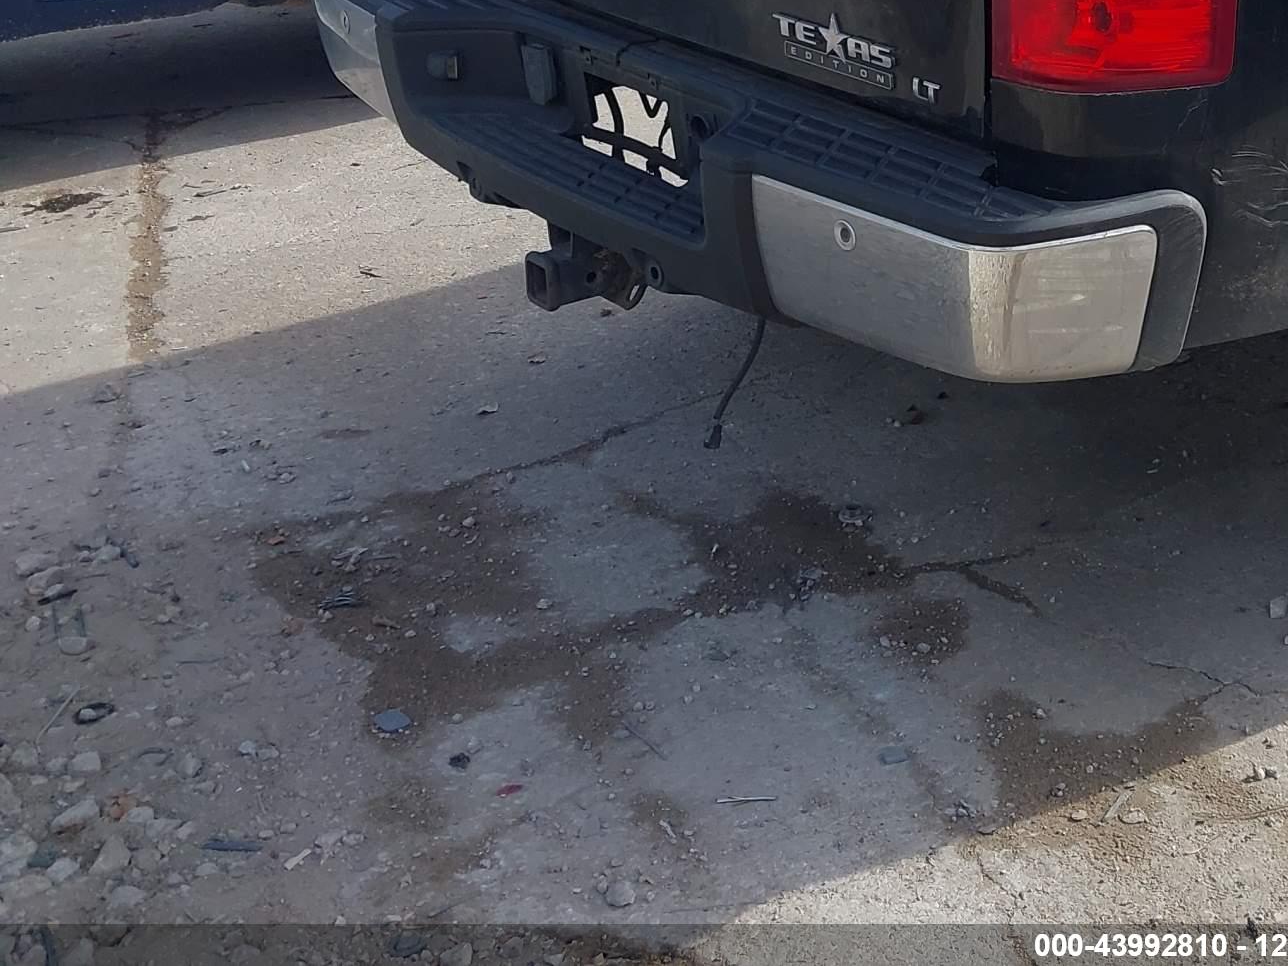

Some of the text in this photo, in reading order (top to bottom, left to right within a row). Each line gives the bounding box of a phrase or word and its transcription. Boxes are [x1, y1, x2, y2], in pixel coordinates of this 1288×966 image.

[771, 12, 896, 70] TEXAS
[790, 45, 886, 84] EDITION
[911, 76, 941, 104] LT
